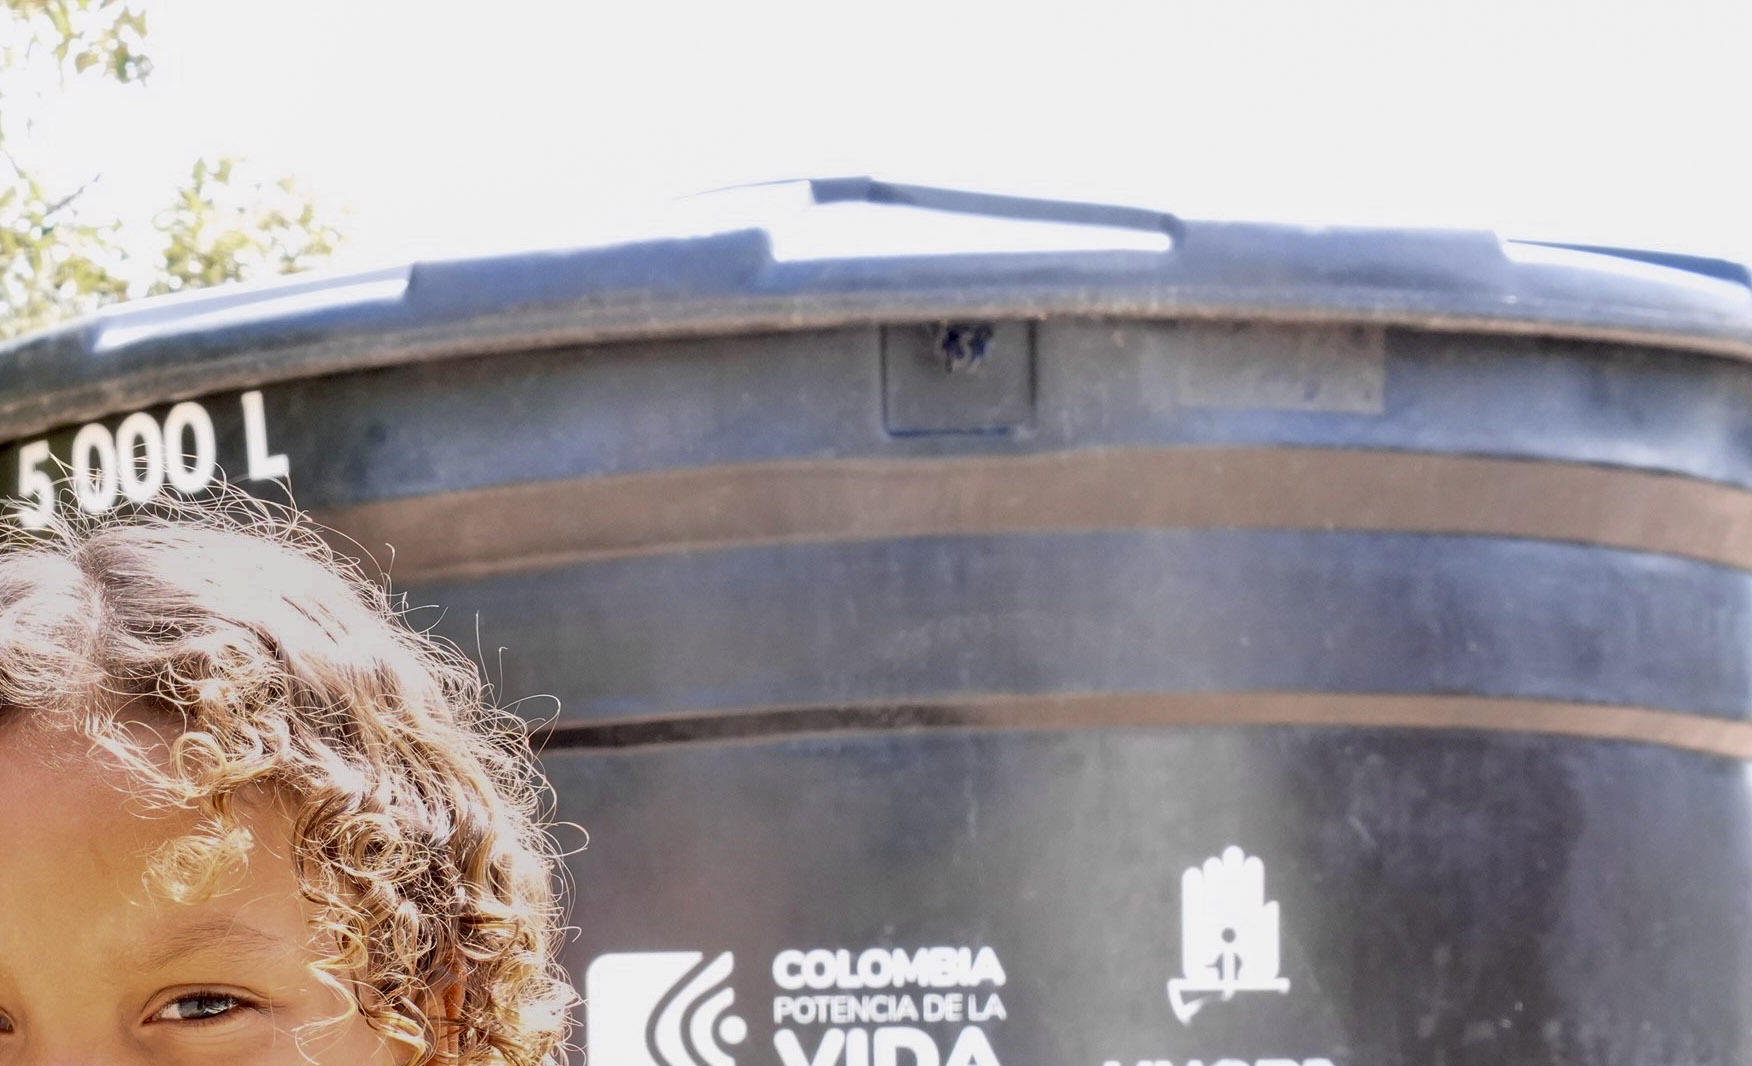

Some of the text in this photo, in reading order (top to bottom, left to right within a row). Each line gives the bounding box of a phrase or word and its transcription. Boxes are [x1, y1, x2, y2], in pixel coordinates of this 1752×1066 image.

[241, 391, 289, 480] L
[772, 946, 1006, 989] COLOMBIA
[773, 993, 1007, 1023] POTENCIA DE LA
